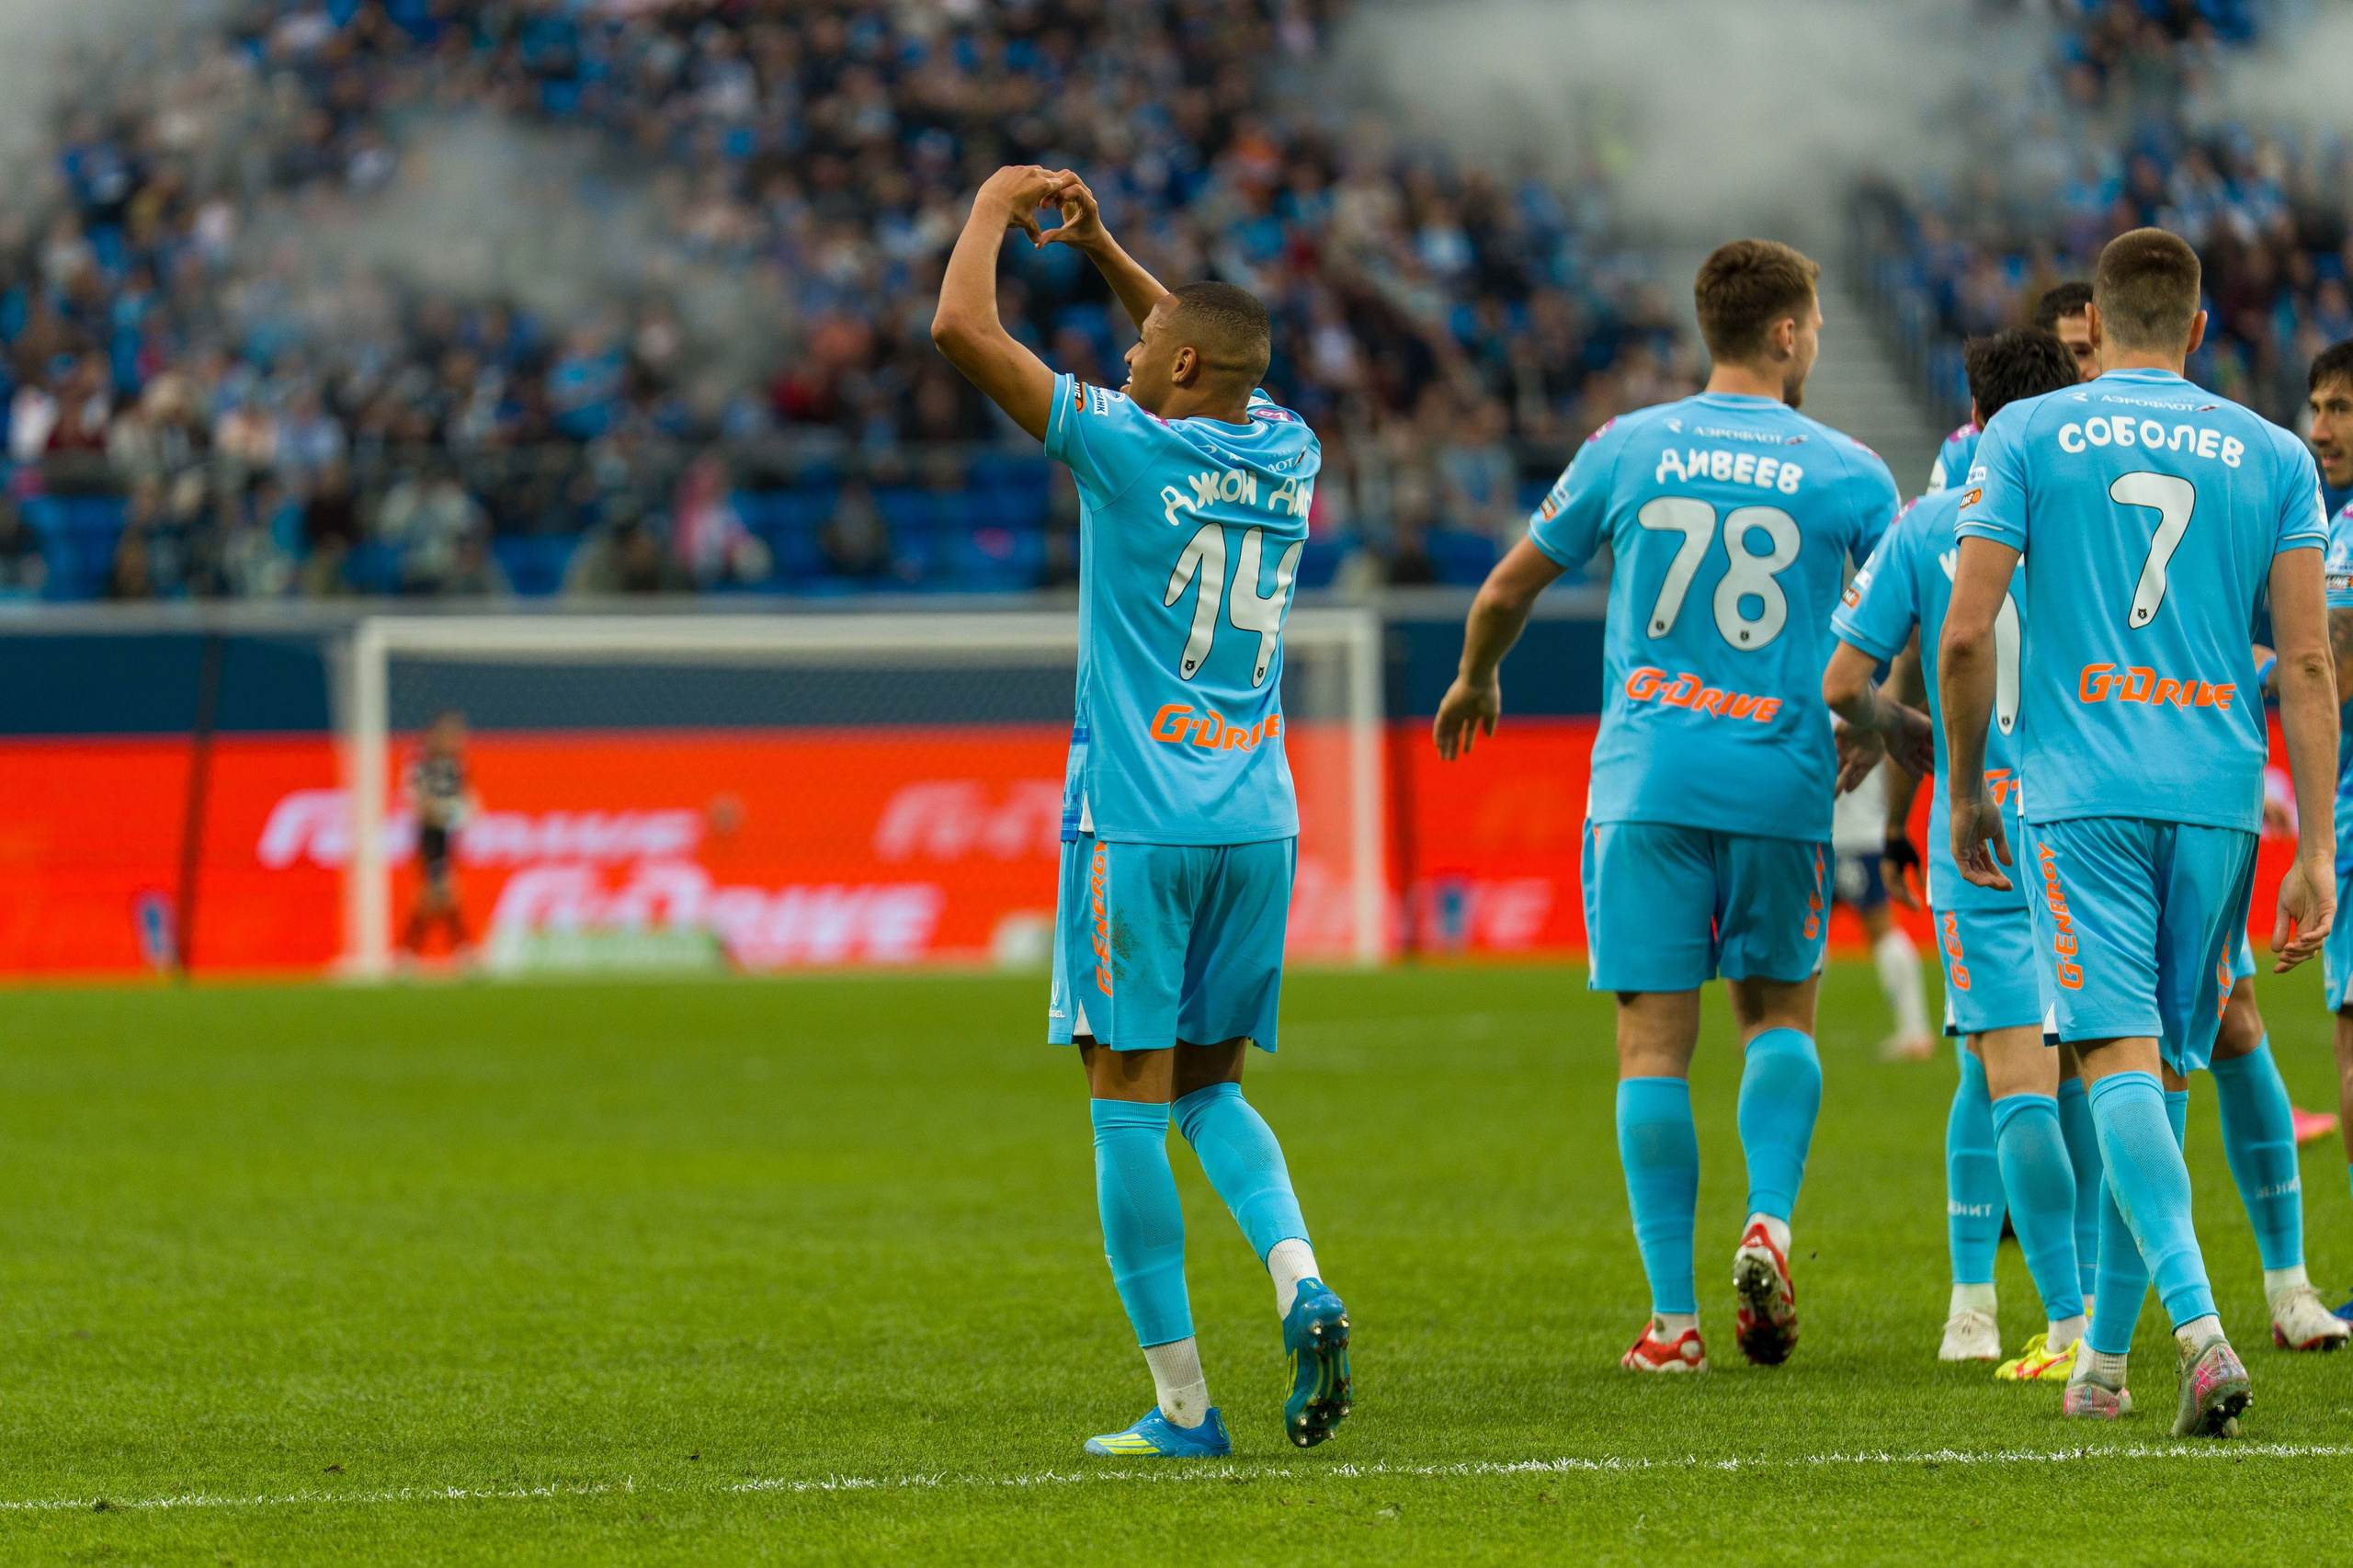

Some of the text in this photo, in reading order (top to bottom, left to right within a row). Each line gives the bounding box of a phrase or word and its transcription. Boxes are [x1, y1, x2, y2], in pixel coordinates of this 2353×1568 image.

[2101, 394, 2195, 412] АЭРОФЛОТ
[2059, 415, 2245, 469] СОБОЛЕВ
[1160, 470, 1256, 527] ДЖОН
[1655, 448, 1803, 494] ДИВЕЕВ
[1638, 495, 1802, 652] 78
[2109, 471, 2196, 630] 7
[1163, 521, 1304, 689] 14
